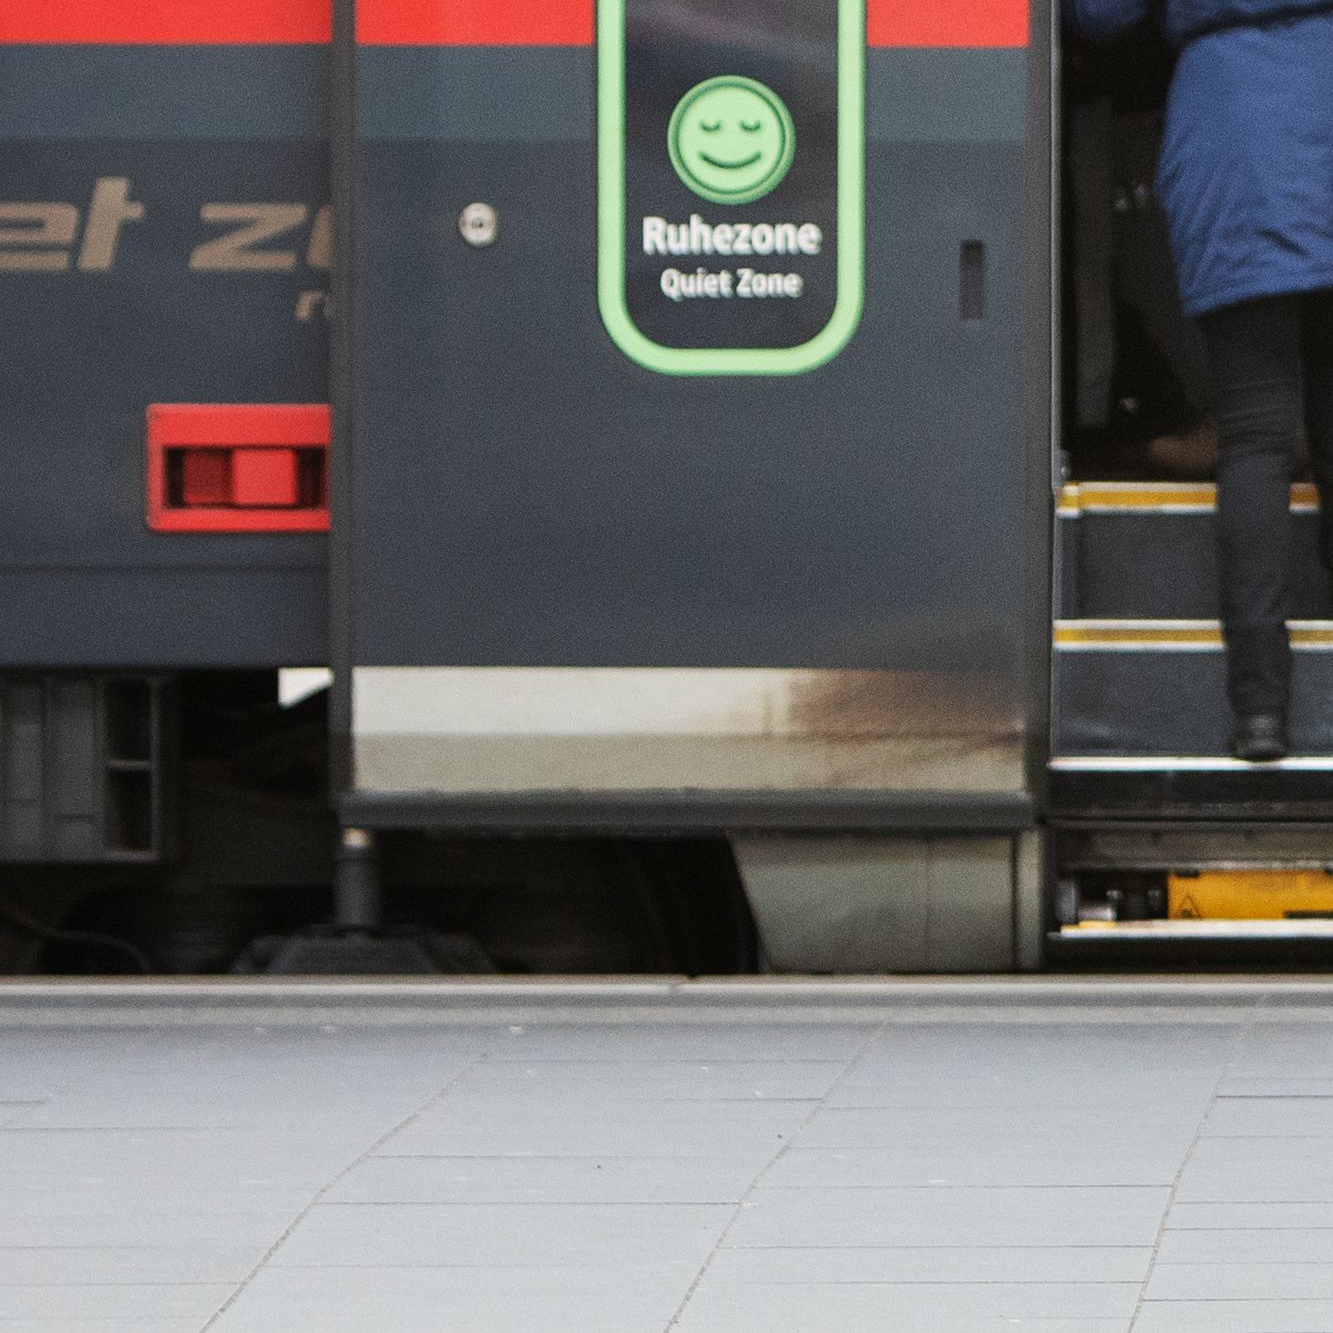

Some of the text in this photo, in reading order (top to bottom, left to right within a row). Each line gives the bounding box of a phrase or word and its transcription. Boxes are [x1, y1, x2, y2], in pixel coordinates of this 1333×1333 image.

[188, 203, 333, 271] z
[643, 214, 822, 255] Ruhezone
[660, 267, 803, 301] Quiet Zone
